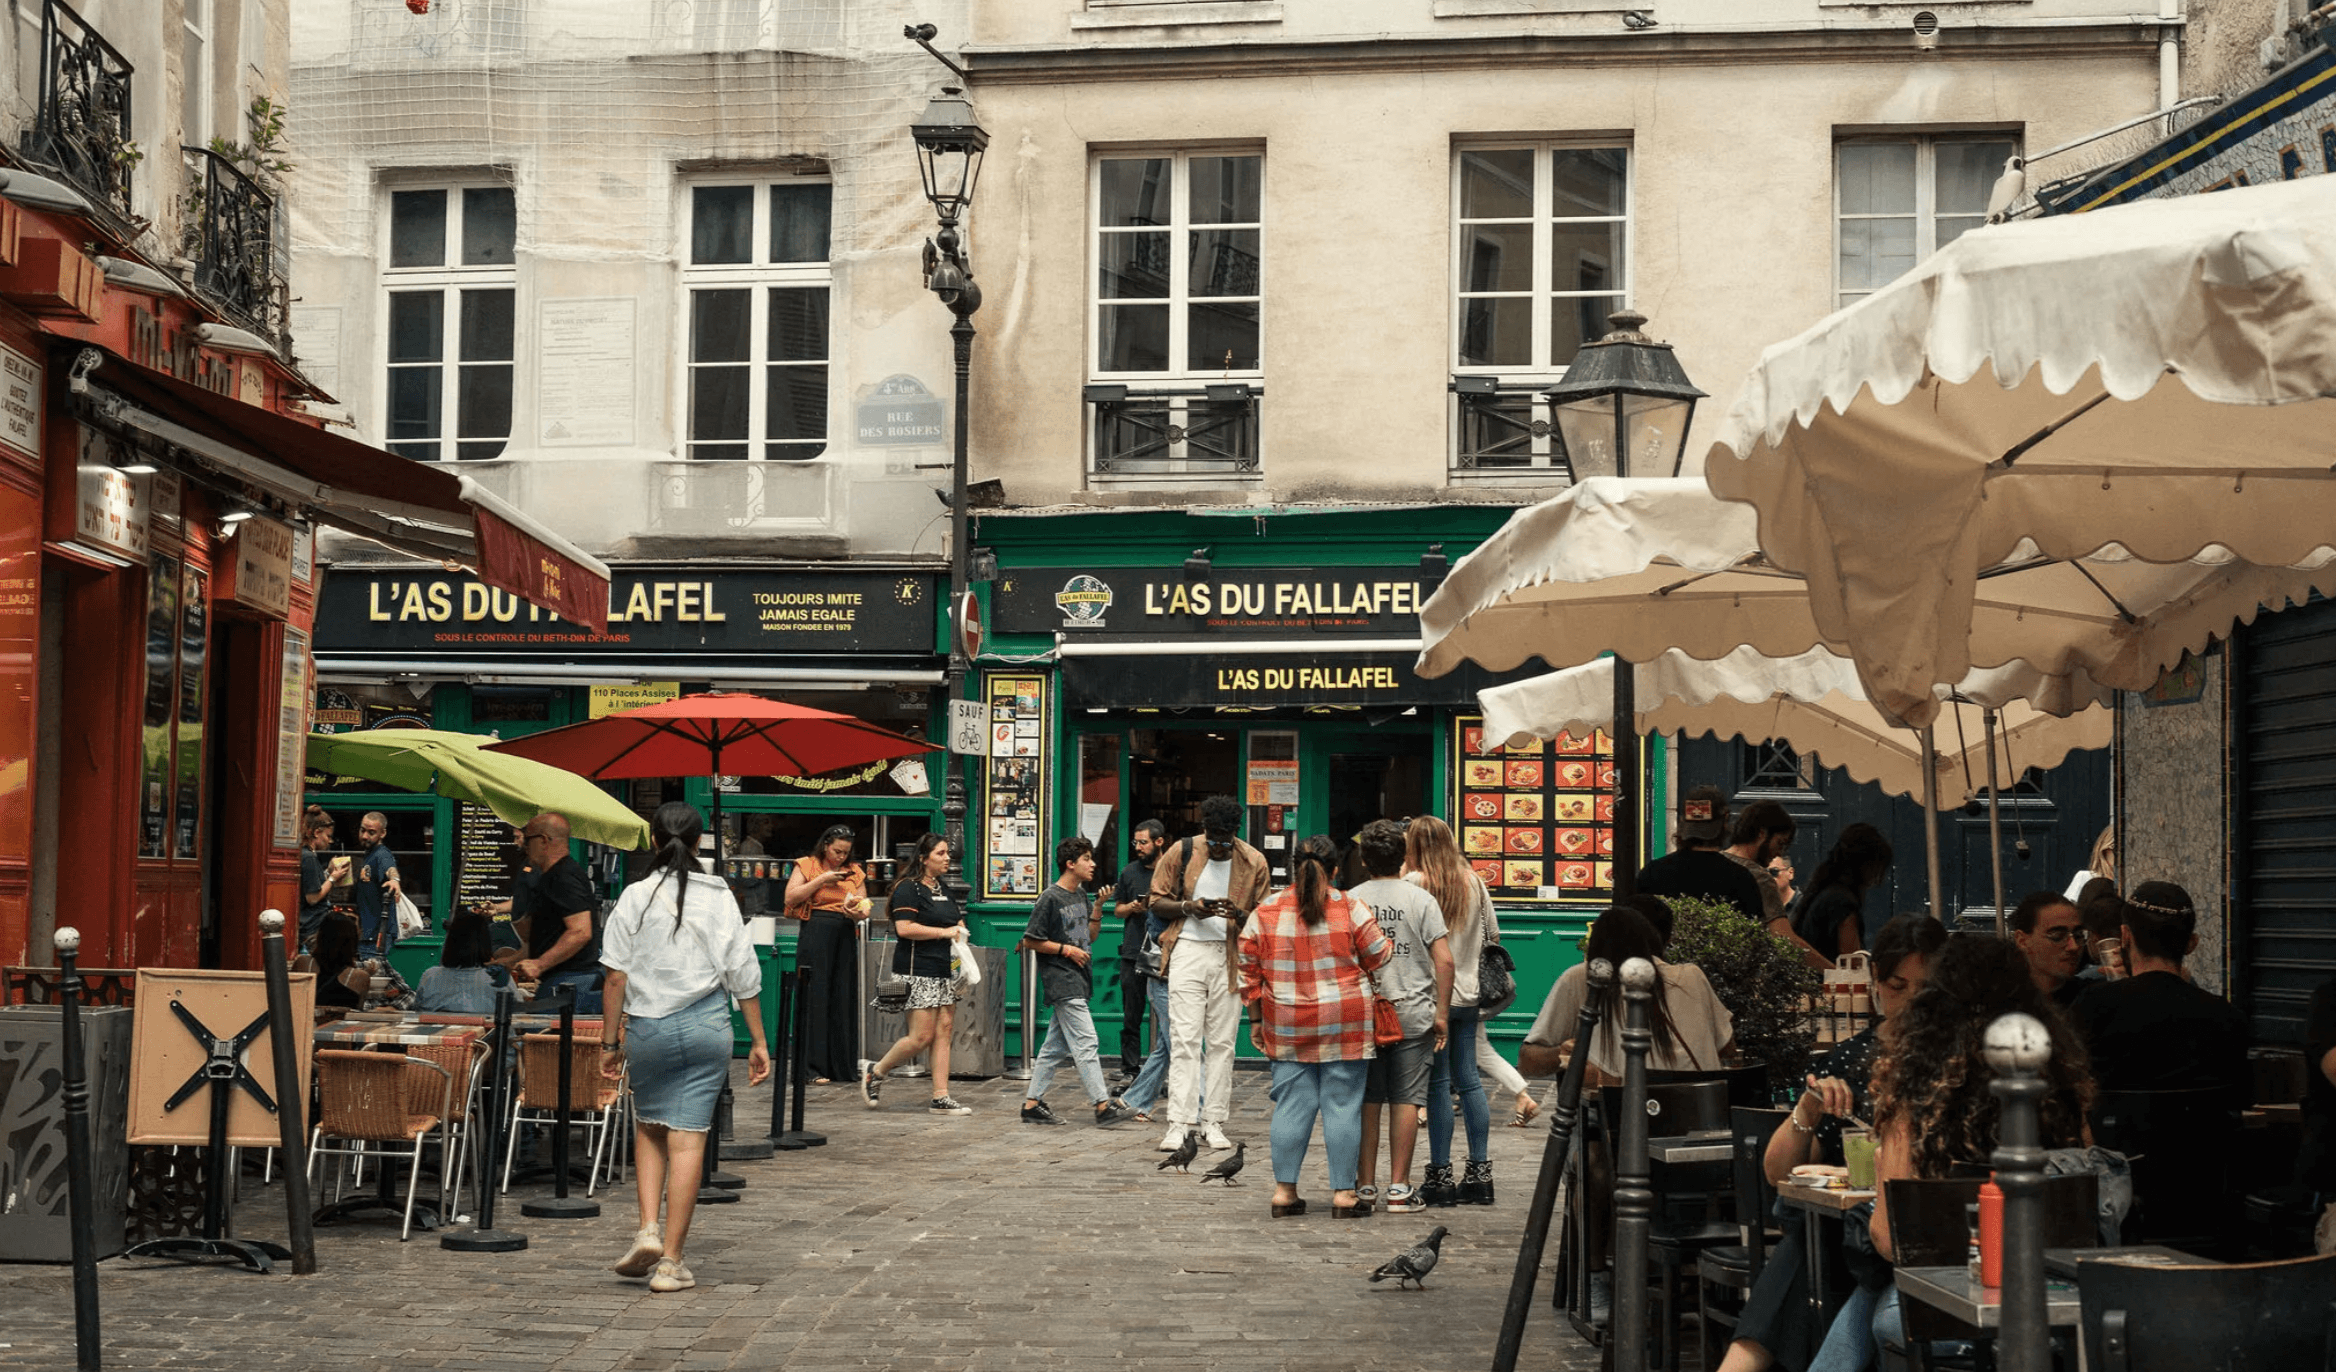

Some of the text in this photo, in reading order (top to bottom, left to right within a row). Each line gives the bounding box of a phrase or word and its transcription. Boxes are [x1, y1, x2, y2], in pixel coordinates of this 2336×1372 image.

[887, 411, 914, 422] RUE
[860, 425, 941, 437] DES ROSIERS
[369, 581, 452, 623] L'AS
[463, 582, 518, 623] DU
[752, 593, 863, 605] TOUJOURS IMITE
[1145, 581, 1424, 616] L'AS DU FALLAFEL
[759, 609, 856, 621] JAMAIS EGALE
[434, 633, 631, 643] SOUS LE CONTROLE DU BETH-DIN DE PARIS
[1217, 667, 1399, 690] L'AS DU FALLAFEL
[594, 688, 676, 697] 110 Places Assises
[608, 699, 614, 708] à
[958, 704, 984, 719] SAUF
